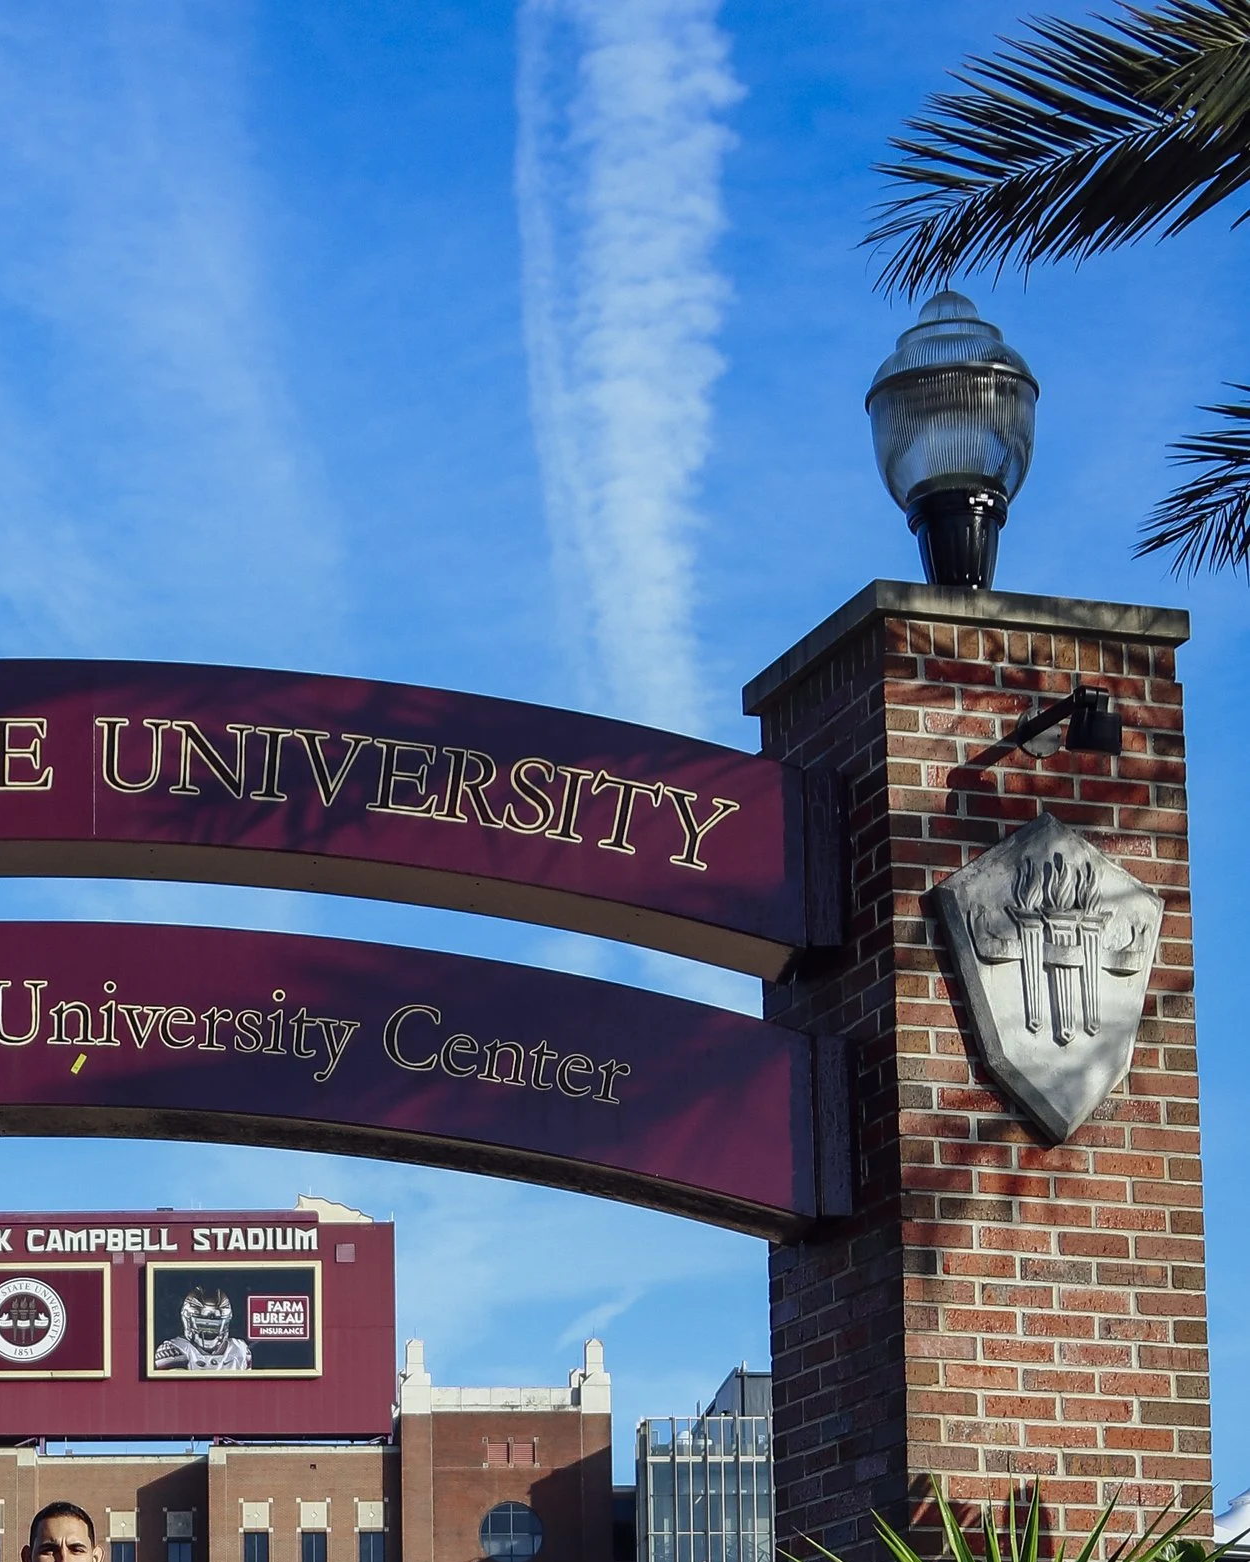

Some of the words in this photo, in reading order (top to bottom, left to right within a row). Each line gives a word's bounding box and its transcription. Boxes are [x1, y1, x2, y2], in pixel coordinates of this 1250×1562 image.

[94, 717, 740, 872] UNIVERSITY
[382, 1003, 632, 1105] Center
[26, 1227, 179, 1253] CAMPBELL
[191, 1226, 320, 1251] STADIUM
[0, 1282, 31, 1297] STATE
[34, 1285, 61, 1341] UNIVERSITY
[267, 1300, 304, 1312] FARM
[252, 1312, 304, 1324] BUREAU
[259, 1327, 304, 1335] INSURANCE
[13, 1348, 34, 1356] 1851
